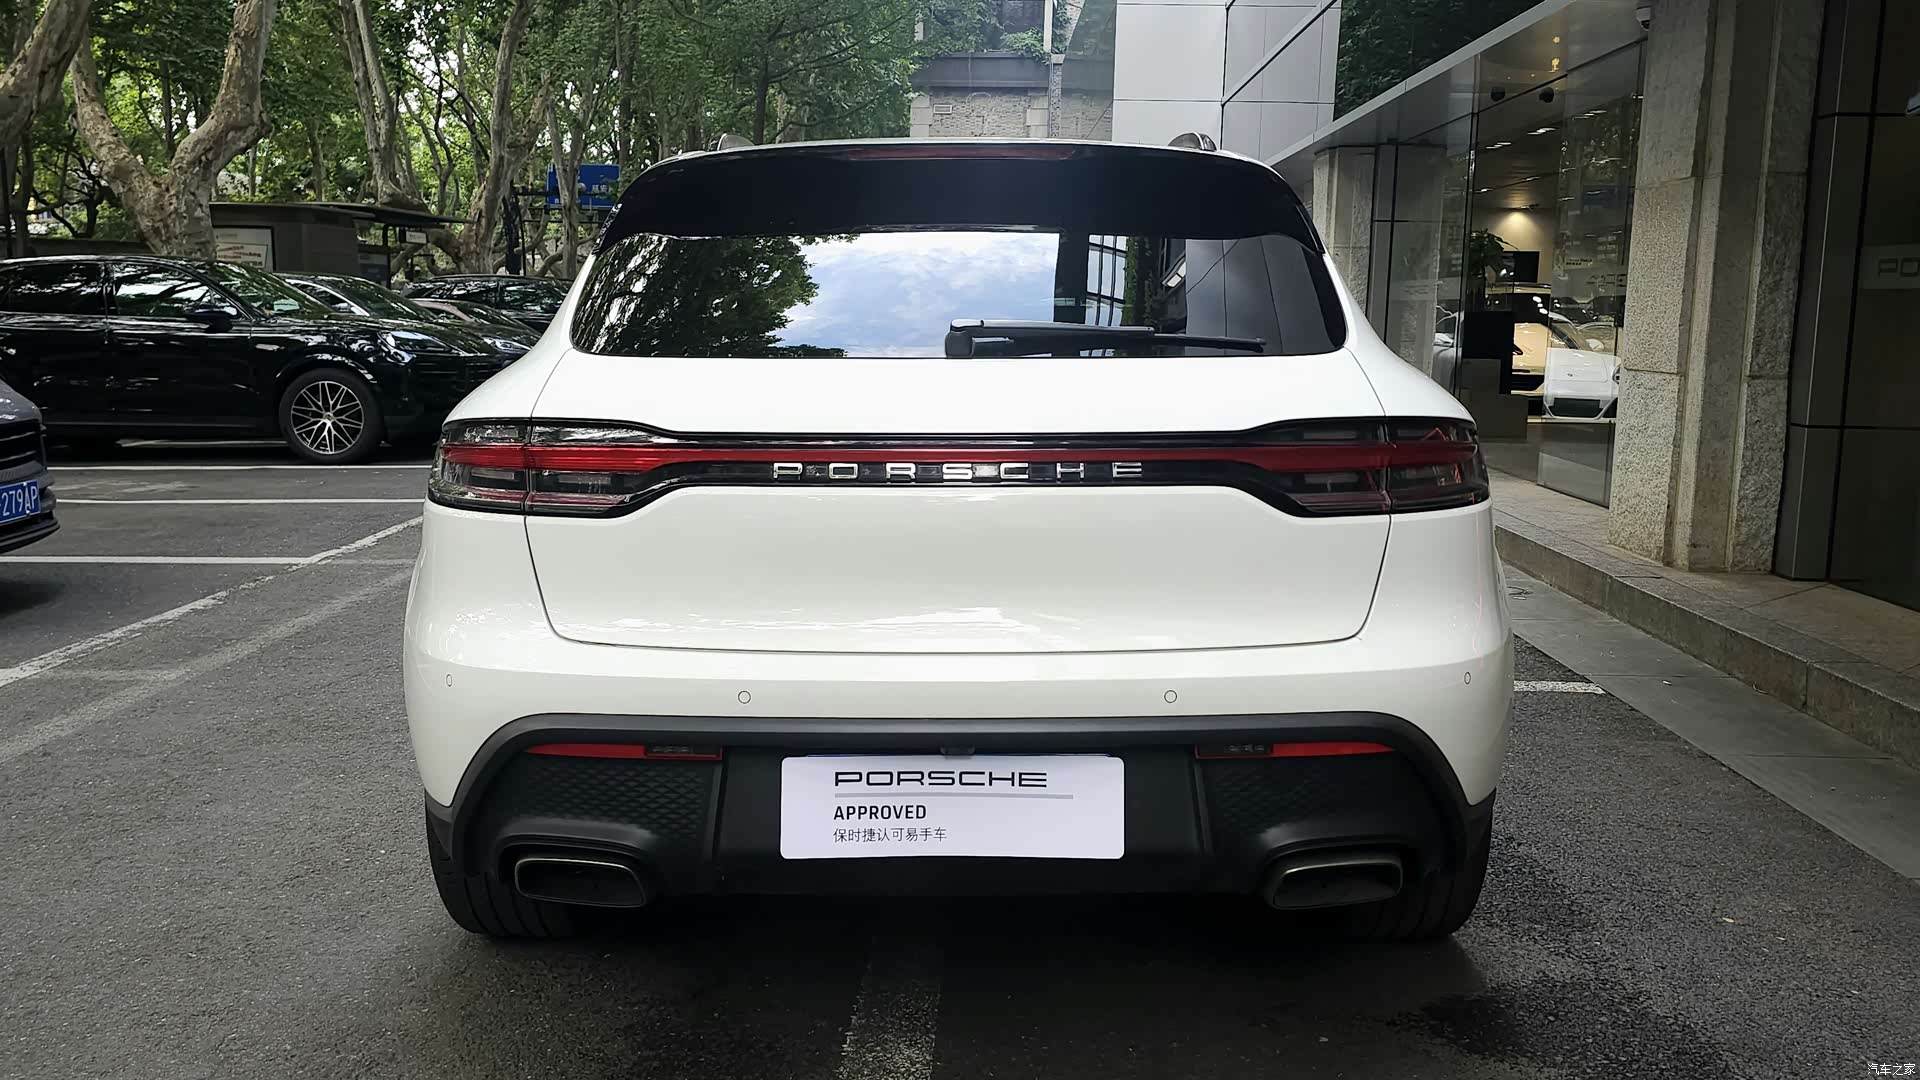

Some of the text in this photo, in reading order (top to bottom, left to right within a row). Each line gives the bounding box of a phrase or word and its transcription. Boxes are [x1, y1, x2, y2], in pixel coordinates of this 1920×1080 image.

[773, 462, 1143, 480] PORSCHE
[834, 770, 1048, 788] PORSCHE
[833, 804, 927, 820] APPROVED
[832, 826, 948, 843] 保时捷认可易手车
